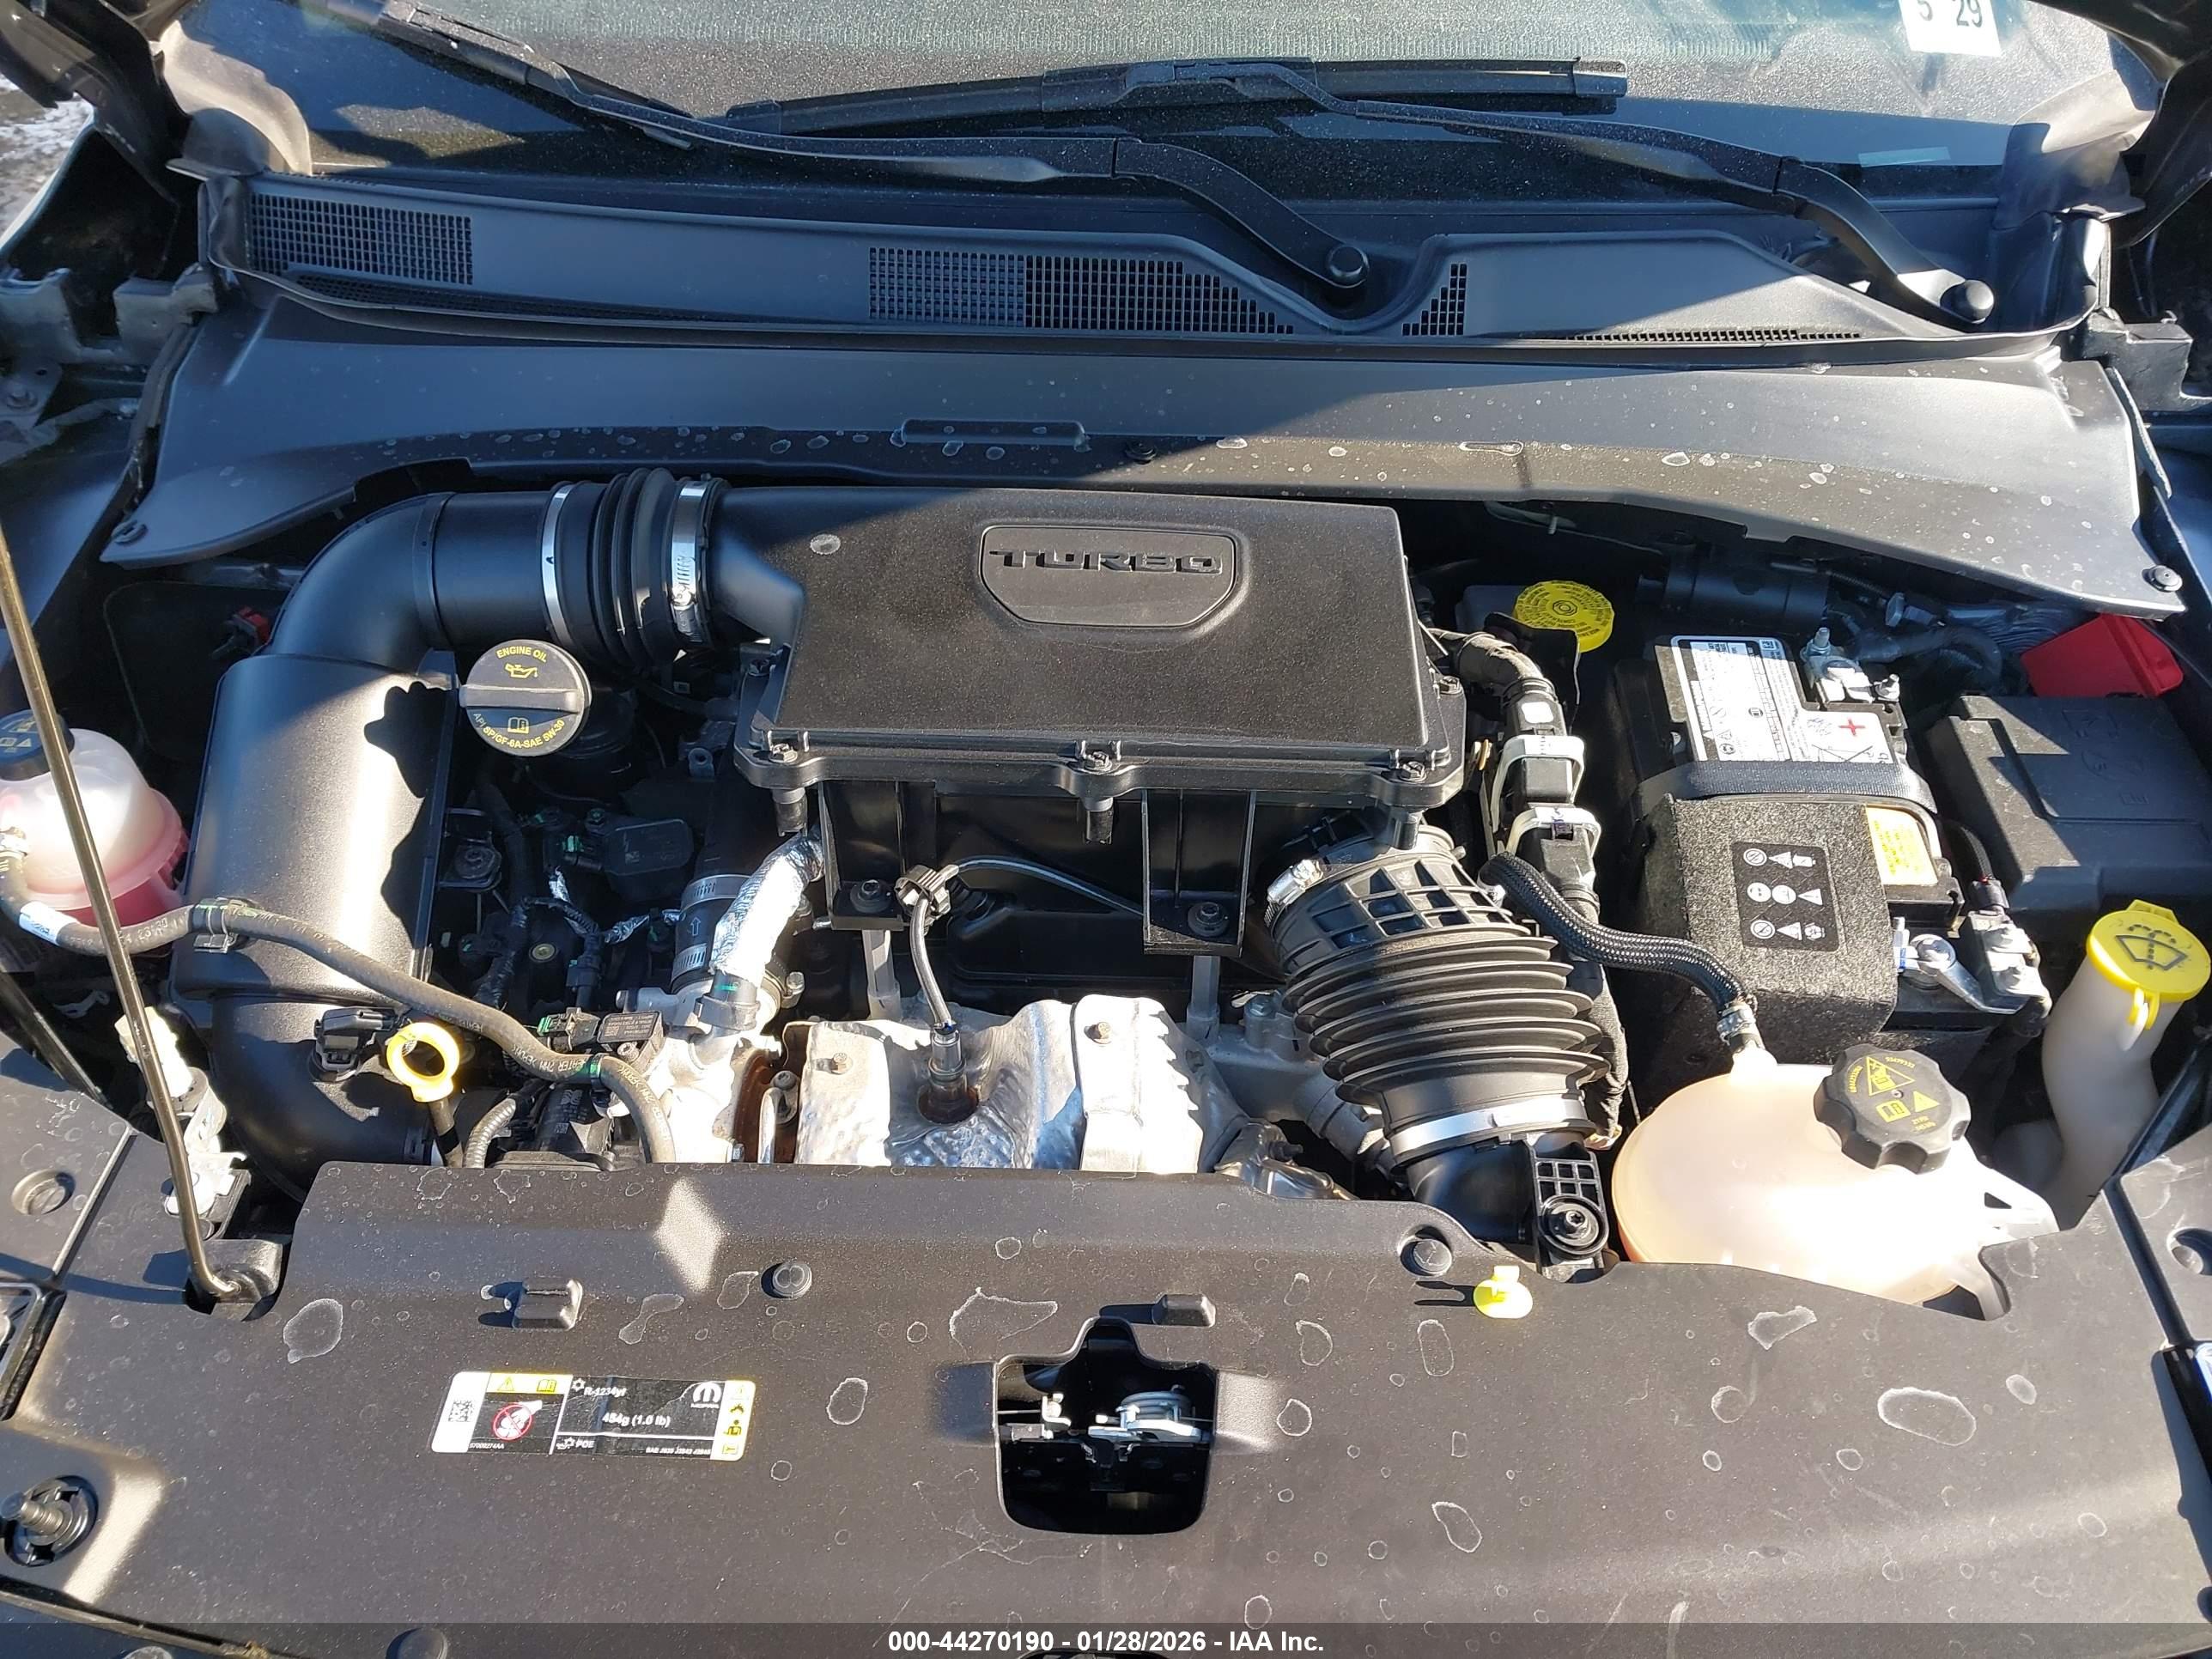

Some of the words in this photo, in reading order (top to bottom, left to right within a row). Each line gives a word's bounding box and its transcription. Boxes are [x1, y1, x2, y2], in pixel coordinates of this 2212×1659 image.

[988, 550, 1223, 574] TURBO
[496, 646, 532, 659] ENGINE
[532, 650, 548, 663] OIL
[473, 712, 483, 728] API
[543, 720, 565, 742] 5W-30
[601, 1412, 630, 1427] 454g
[631, 1414, 654, 1427] (1.0
[655, 1415, 672, 1429] lb)
[575, 1440, 596, 1449] POE
